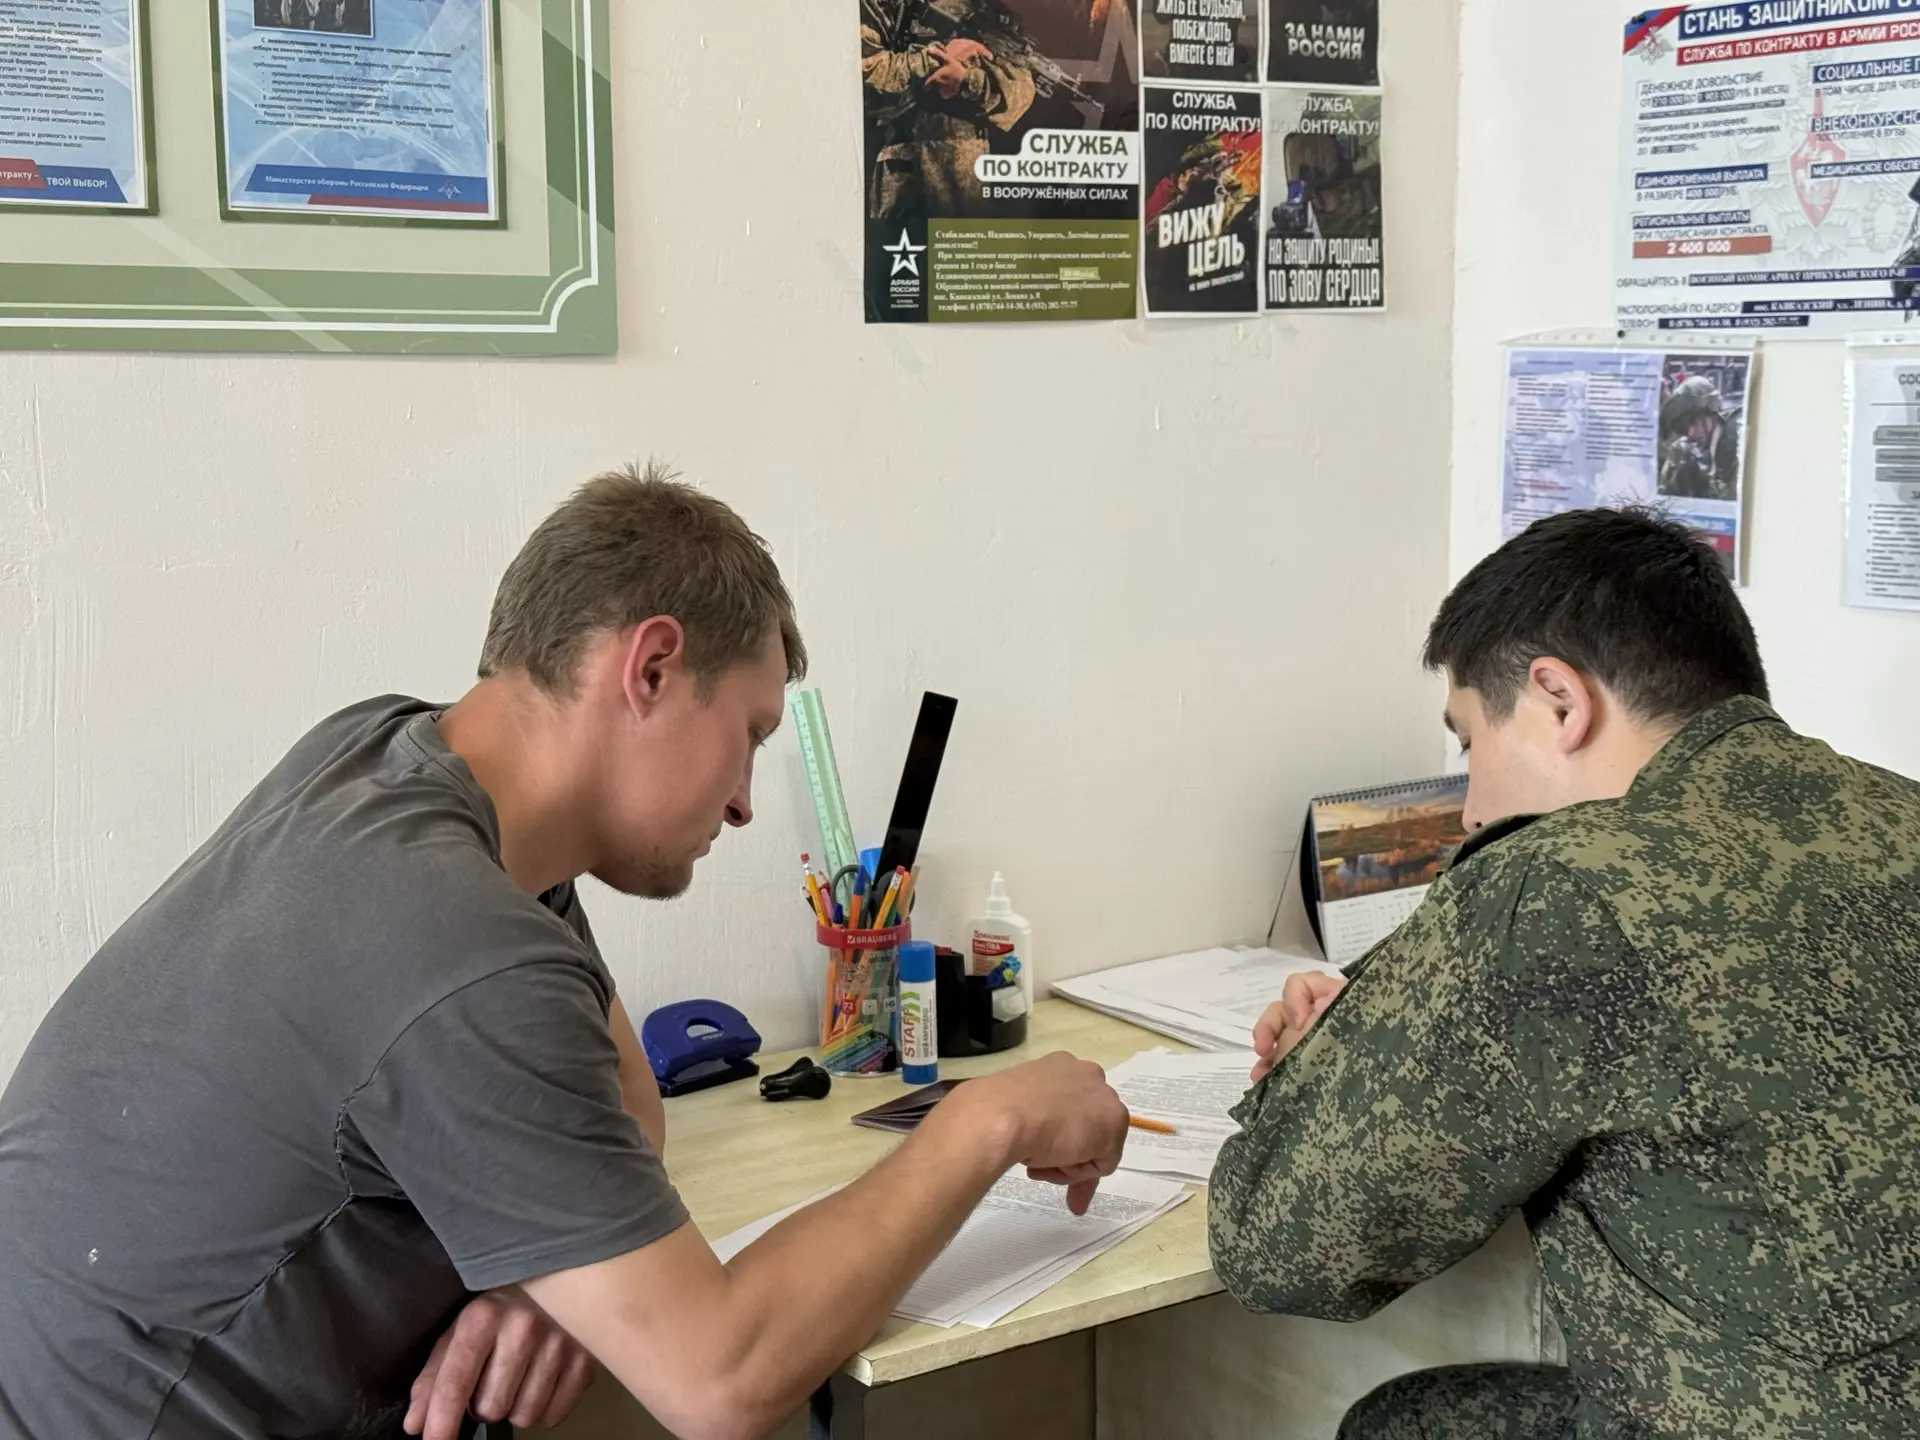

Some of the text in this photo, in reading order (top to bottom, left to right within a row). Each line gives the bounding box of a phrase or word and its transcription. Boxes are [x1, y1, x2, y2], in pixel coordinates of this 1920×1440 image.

[1172, 19, 1231, 43] ПОБЕЖДАТЬ
[1684, 7, 1743, 34] СТАНЬ
[1284, 22, 1365, 43] ЗА НАМИ
[1170, 42, 1235, 67] ВМЕСТЕ С НЕЙ
[1288, 38, 1362, 60] РОССИЯ
[1682, 45, 1733, 63] СЛУЖБА
[1735, 43, 1751, 56] ПО
[1754, 33, 1824, 53] КОНТРАКТУ
[1826, 32, 1836, 46] В
[1839, 25, 1887, 42] АРМИИ
[1817, 58, 1911, 81] СОЦИАЛЬНЫЕ
[1172, 92, 1236, 111] СЛУЖБА
[1296, 96, 1355, 113] ЛУЖБА
[1145, 113, 1261, 133] ПО КОНТРАКТУ!
[1030, 133, 1129, 156] СЛУЖБА
[983, 159, 1129, 179] ПО КОНТРАКТУ
[47, 176, 72, 188] ТВОЙ
[73, 178, 109, 189] ВЫБОР!
[265, 175, 430, 192] Министерство обороны Российской Федерации
[982, 187, 1129, 200] В ВООРУЖЁННЫХ СИЛАХ
[1158, 202, 1225, 248] ВИЖУ
[1188, 233, 1246, 278] ЦЕЛЬ
[1269, 238, 1282, 264] НА
[1284, 238, 1327, 269] ЗАЩИТУ
[1667, 240, 1732, 255] 2 400 000
[1269, 268, 1380, 306] ПО ЗОВУ СЕРДЦА
[856, 934, 898, 945] BRAUBERG
[903, 1008, 915, 1058] STAFF
